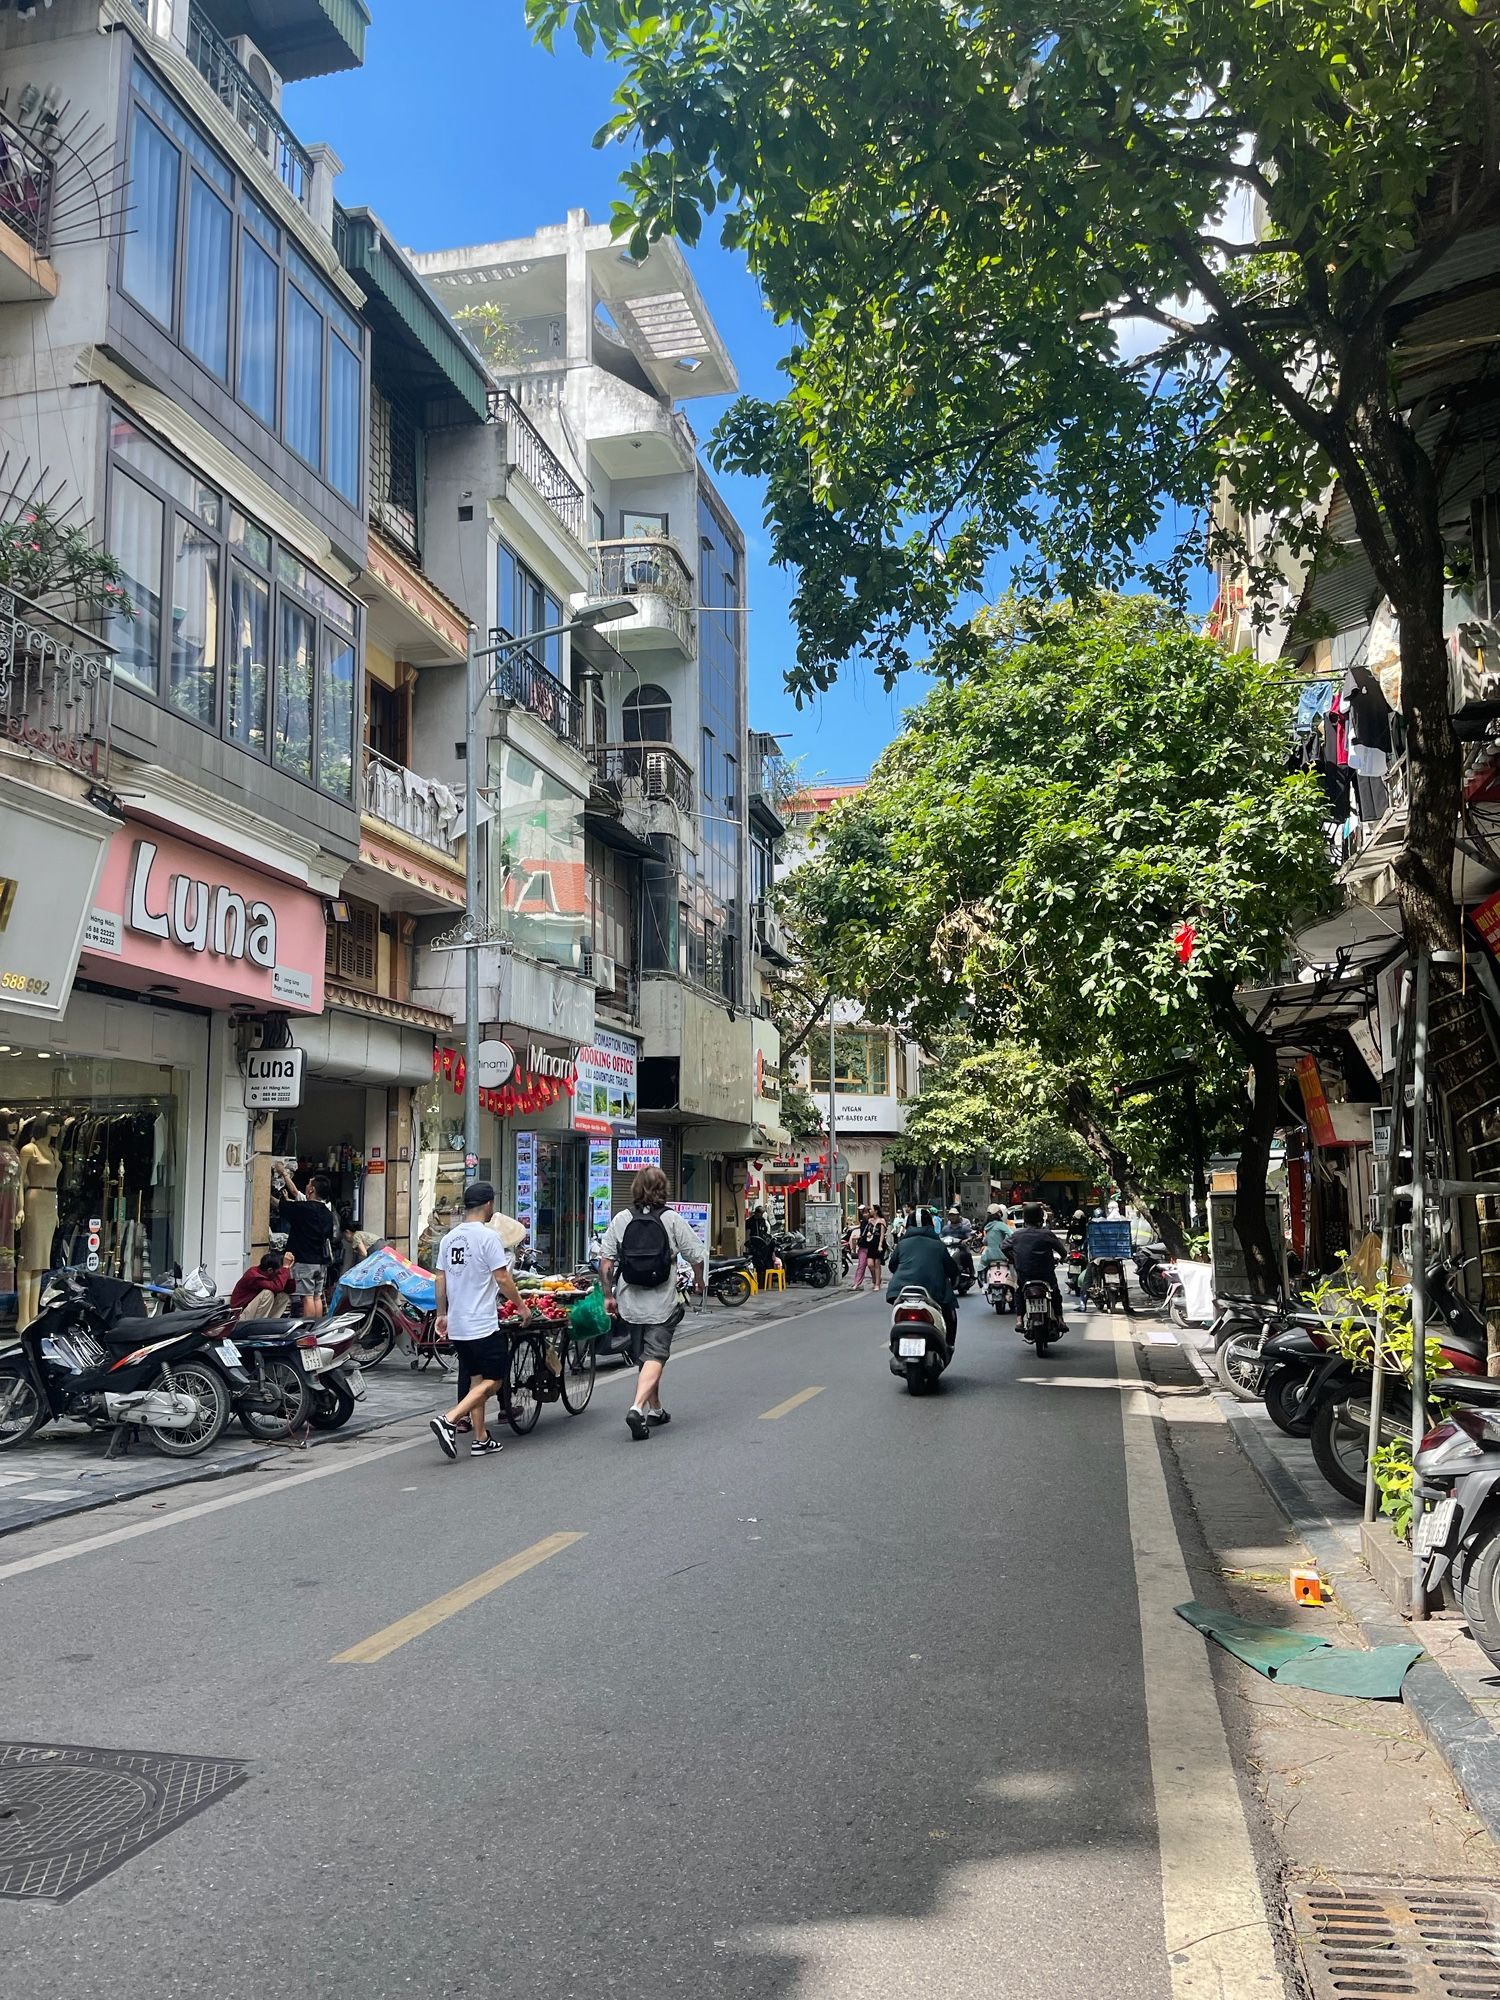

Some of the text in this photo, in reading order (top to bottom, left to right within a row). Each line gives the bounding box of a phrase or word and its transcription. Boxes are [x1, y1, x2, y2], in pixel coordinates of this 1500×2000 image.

[125, 839, 276, 969] Luna
[622, 1041, 636, 1057] CENTER
[248, 1056, 294, 1079] Luna
[479, 1060, 508, 1069] inami
[580, 1046, 634, 1076] BOOKING OFFICE
[593, 1071, 615, 1085] ADVENTURE
[615, 1075, 629, 1088] TRAVEL
[618, 1140, 660, 1148] BOOKING OFFICE
